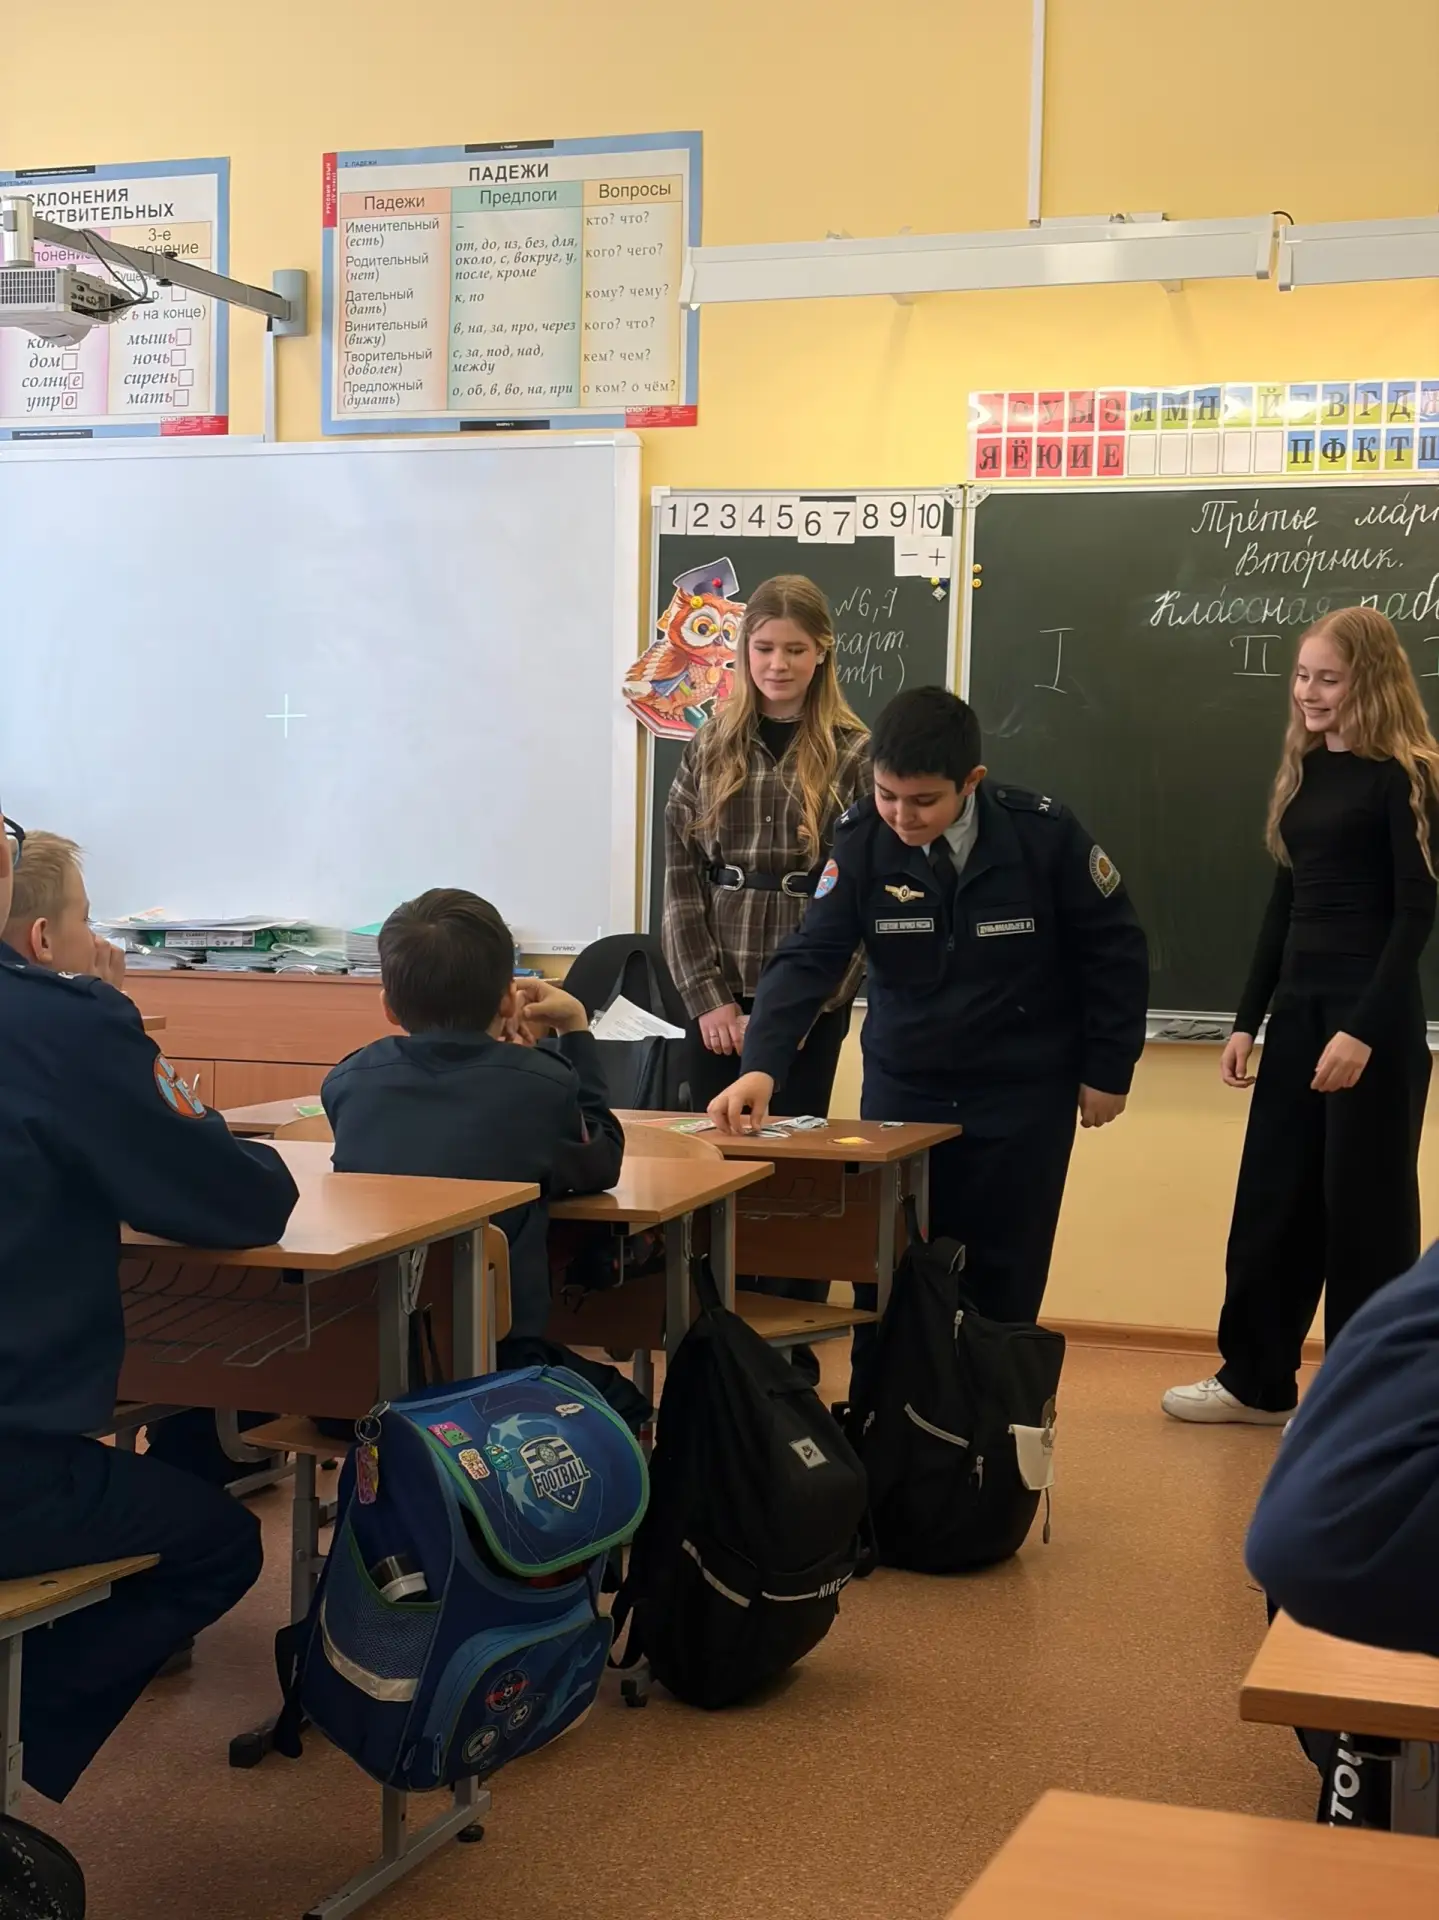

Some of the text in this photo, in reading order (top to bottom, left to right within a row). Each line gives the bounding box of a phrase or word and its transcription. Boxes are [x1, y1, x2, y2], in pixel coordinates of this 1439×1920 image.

[469, 163, 550, 182] ПАДЕЖИ
[480, 188, 558, 207] Предлоги
[599, 182, 671, 200] Вопросы
[364, 196, 425, 212] Падежи
[586, 211, 649, 226] кто? что?
[148, 228, 171, 242] 3-е
[345, 219, 439, 235] Именительный
[345, 235, 385, 249] (есть)
[455, 235, 578, 253] от, до, из, без, для,
[455, 255, 497, 268] около,
[513, 251, 562, 268] вокруг,
[565, 253, 577, 266] у,
[585, 243, 663, 260] кого? чего?
[346, 252, 429, 269] Родительный
[346, 269, 380, 283] (нет)
[455, 267, 537, 282] после, кроме
[345, 288, 414, 305] Дательный
[454, 292, 485, 304] к, по
[585, 283, 670, 302] кому? чему?
[143, 310, 159, 320] на
[163, 305, 206, 320] конце)
[345, 301, 387, 317] (дать)
[344, 318, 428, 334] Винительный
[468, 324, 487, 335] на,
[491, 323, 508, 334] за,
[511, 322, 538, 336] про,
[542, 321, 576, 335] через
[584, 316, 656, 333] кого? что?
[126, 332, 175, 346] мышь
[344, 332, 387, 348] (вижу)
[132, 352, 171, 364] ночь
[343, 349, 433, 365] Творительный
[466, 349, 483, 359] за,
[486, 345, 514, 359] под,
[516, 344, 544, 358] над,
[583, 349, 651, 362] кем? чем?
[29, 353, 61, 368] дом
[452, 360, 496, 375] между
[343, 361, 403, 377] (доволен)
[21, 374, 81, 391] солнце
[123, 373, 178, 387] сирень
[595, 381, 627, 394] ком?
[645, 379, 676, 393] чём?
[343, 380, 423, 397] Предложный
[467, 384, 486, 397] об,
[504, 384, 524, 396] во,
[527, 385, 547, 397] на,
[550, 384, 574, 398] при
[26, 395, 75, 412] утро
[126, 391, 173, 405] мать
[343, 394, 400, 409] (думать)
[1104, 398, 1119, 423] Э
[1133, 397, 1154, 422] Л
[1165, 396, 1189, 421] М
[1197, 395, 1217, 420] Н
[1327, 391, 1345, 417] В
[1360, 390, 1377, 416] Г
[1390, 390, 1411, 422] Д
[980, 446, 999, 470] Я
[1012, 440, 1027, 469] Ё
[1037, 444, 1062, 468] Ю
[1071, 444, 1091, 468] И
[1103, 444, 1119, 468] Е
[1290, 438, 1312, 464] П
[1322, 438, 1346, 462] Ф
[1357, 437, 1376, 462] К
[1391, 436, 1409, 461] Т
[667, 502, 941, 537] 1 2 3 4 5 6 7 8 9 10
[533, 1458, 590, 1497] FOOTBALL
[818, 1577, 842, 1599] NIKE
